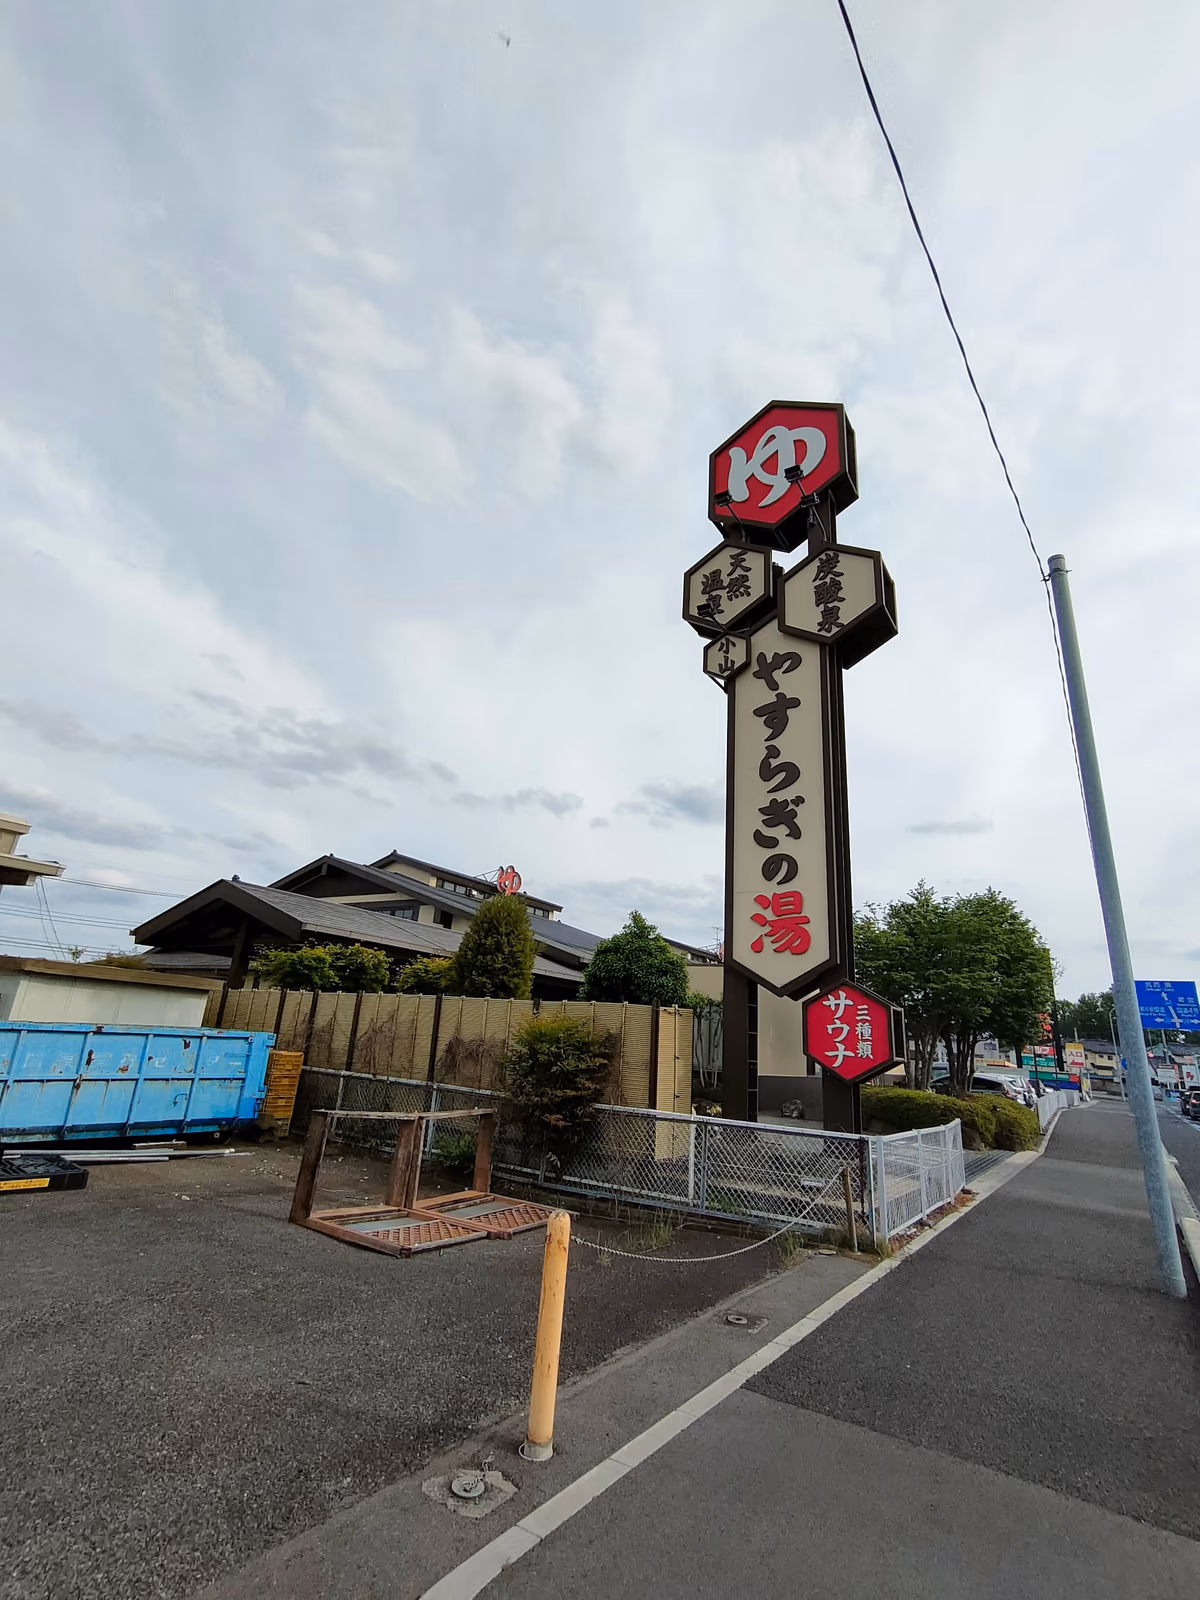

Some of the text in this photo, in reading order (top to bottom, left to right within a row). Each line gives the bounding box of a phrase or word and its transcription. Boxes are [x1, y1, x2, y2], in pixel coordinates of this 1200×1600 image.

[728, 425, 826, 507] ゆ
[727, 550, 752, 601] 天然
[812, 552, 846, 633] 炭酸泉
[718, 637, 736, 674] 小山
[750, 651, 811, 956] やすらぎの湯
[822, 990, 855, 1068] サウナ
[855, 1005, 873, 1059] 三種類
